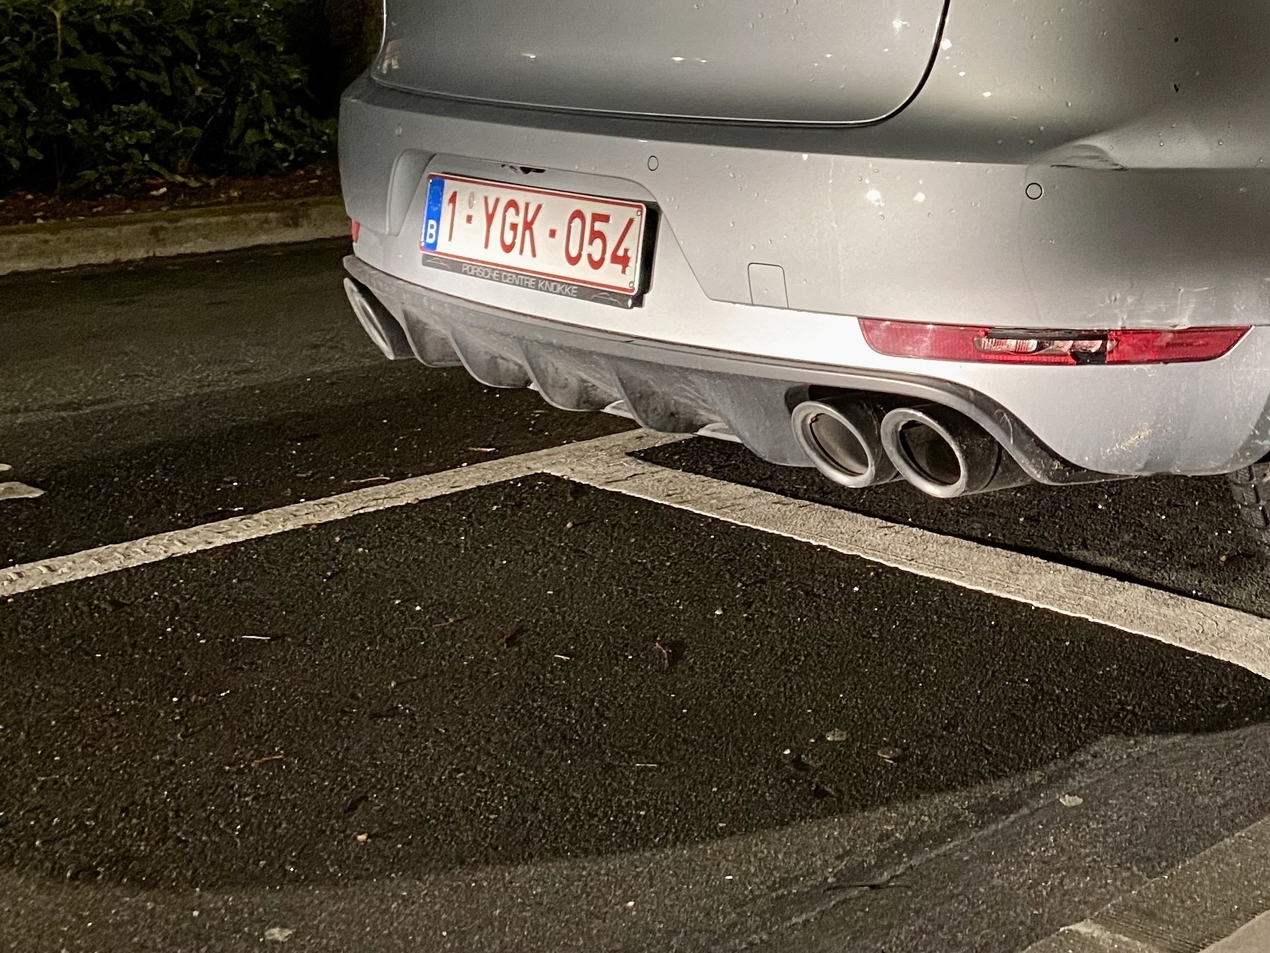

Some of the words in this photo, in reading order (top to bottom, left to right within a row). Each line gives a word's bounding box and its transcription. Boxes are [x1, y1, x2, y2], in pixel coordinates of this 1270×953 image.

[425, 219, 438, 244] B
[461, 263, 500, 282] PORSCHE
[500, 272, 536, 289] CENTRE
[537, 279, 579, 298] KNOKKE
